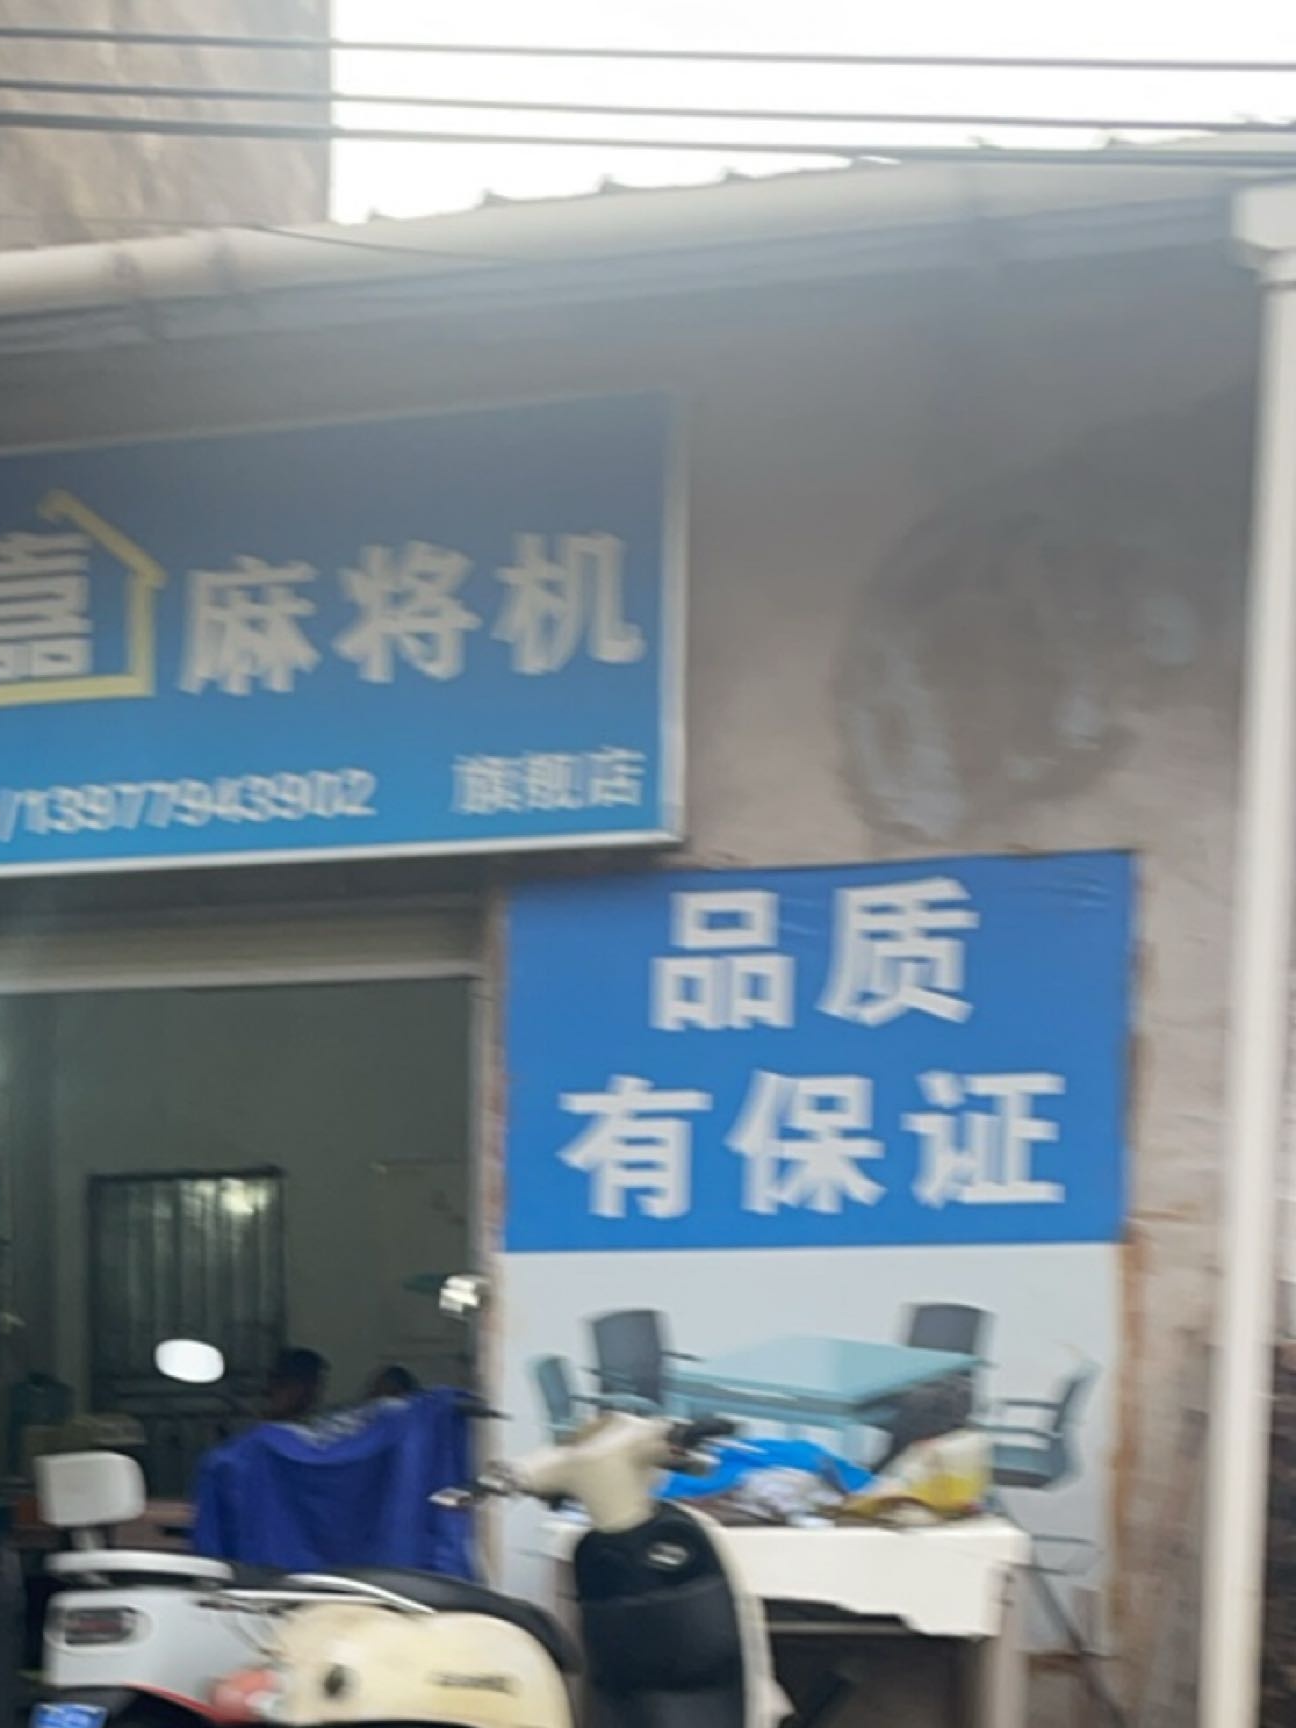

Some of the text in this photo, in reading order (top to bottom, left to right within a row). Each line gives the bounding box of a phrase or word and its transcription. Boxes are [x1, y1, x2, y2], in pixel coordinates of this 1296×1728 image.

[177, 530, 647, 697] 麻将机
[648, 876, 981, 1032] 品质
[556, 1067, 1068, 1221] 有保证
